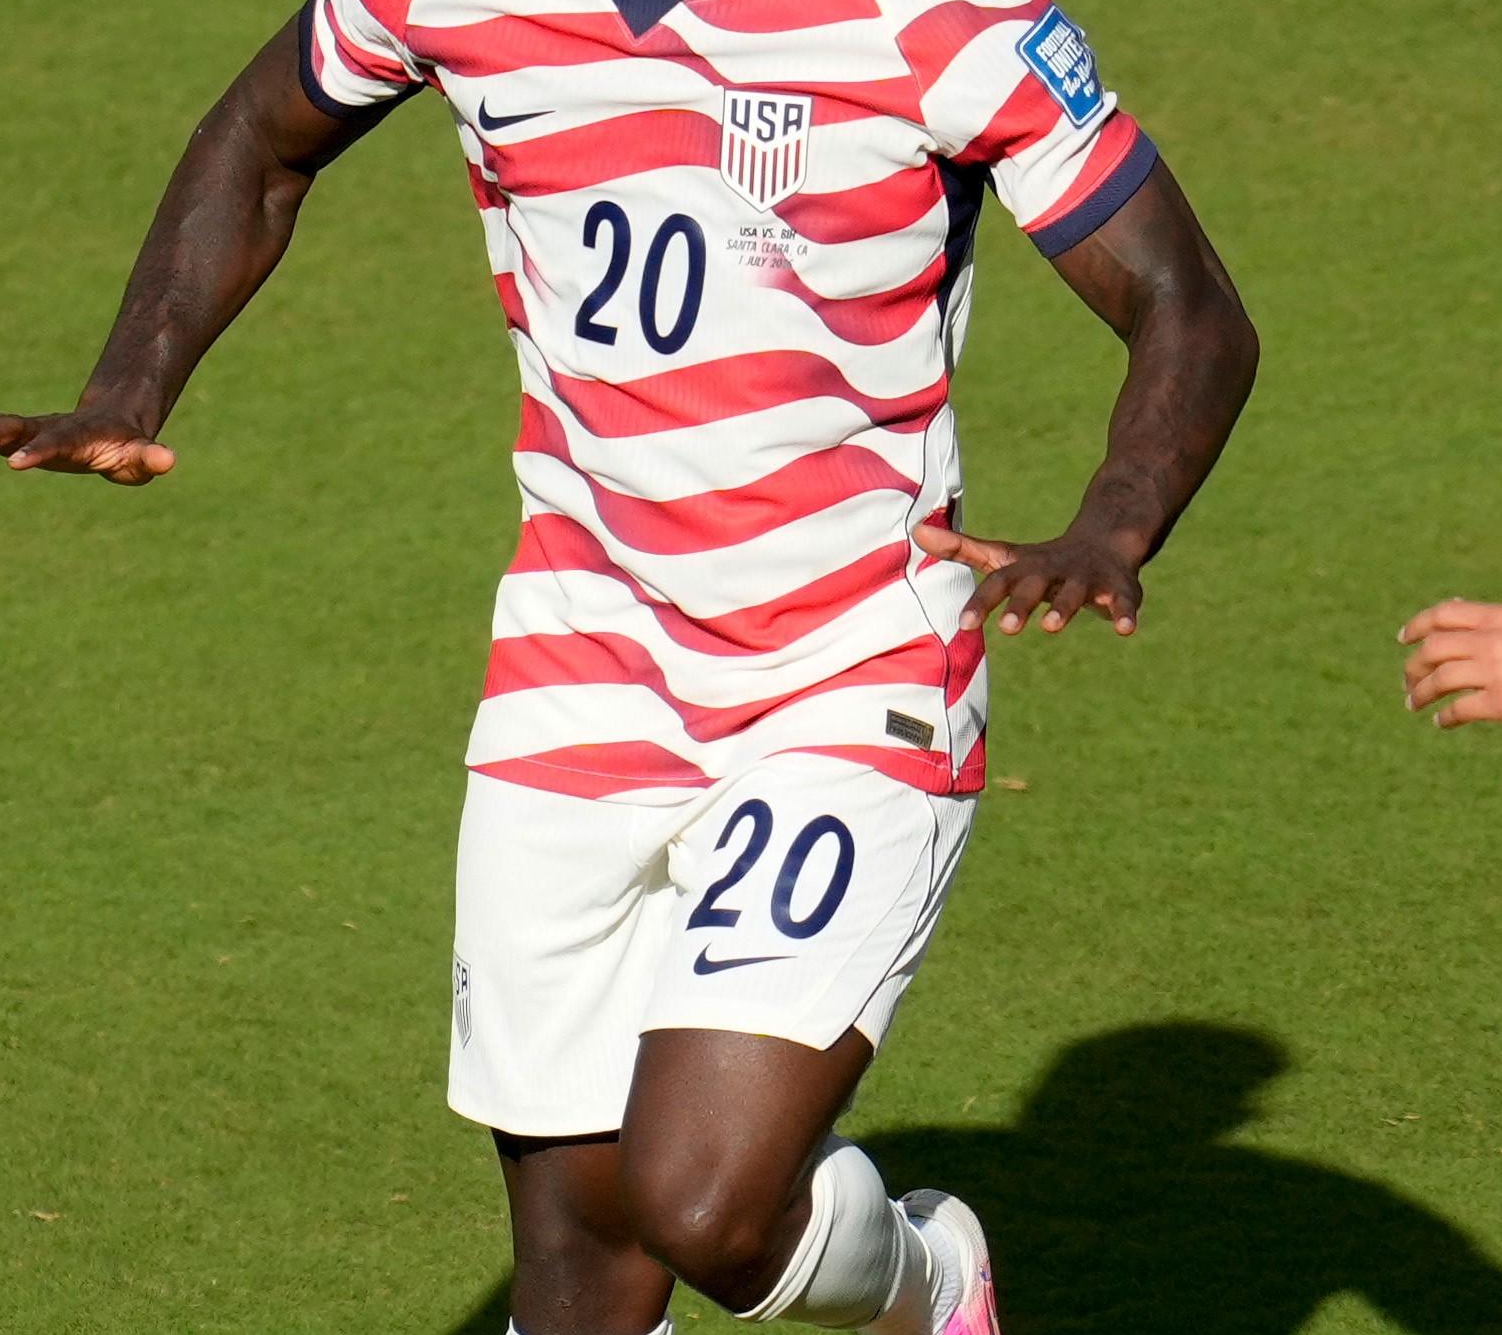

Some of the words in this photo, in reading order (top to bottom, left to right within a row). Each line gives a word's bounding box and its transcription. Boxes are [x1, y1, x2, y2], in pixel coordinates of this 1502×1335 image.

[1047, 32, 1084, 79] UNITE
[730, 98, 804, 143] USA
[725, 239, 757, 252] SANTA
[796, 244, 809, 257] CA
[739, 226, 758, 238] USA
[762, 227, 776, 239] VS.
[574, 200, 707, 356] 20
[744, 255, 767, 268] JULY
[684, 797, 857, 940] 20
[455, 960, 468, 996] SA
